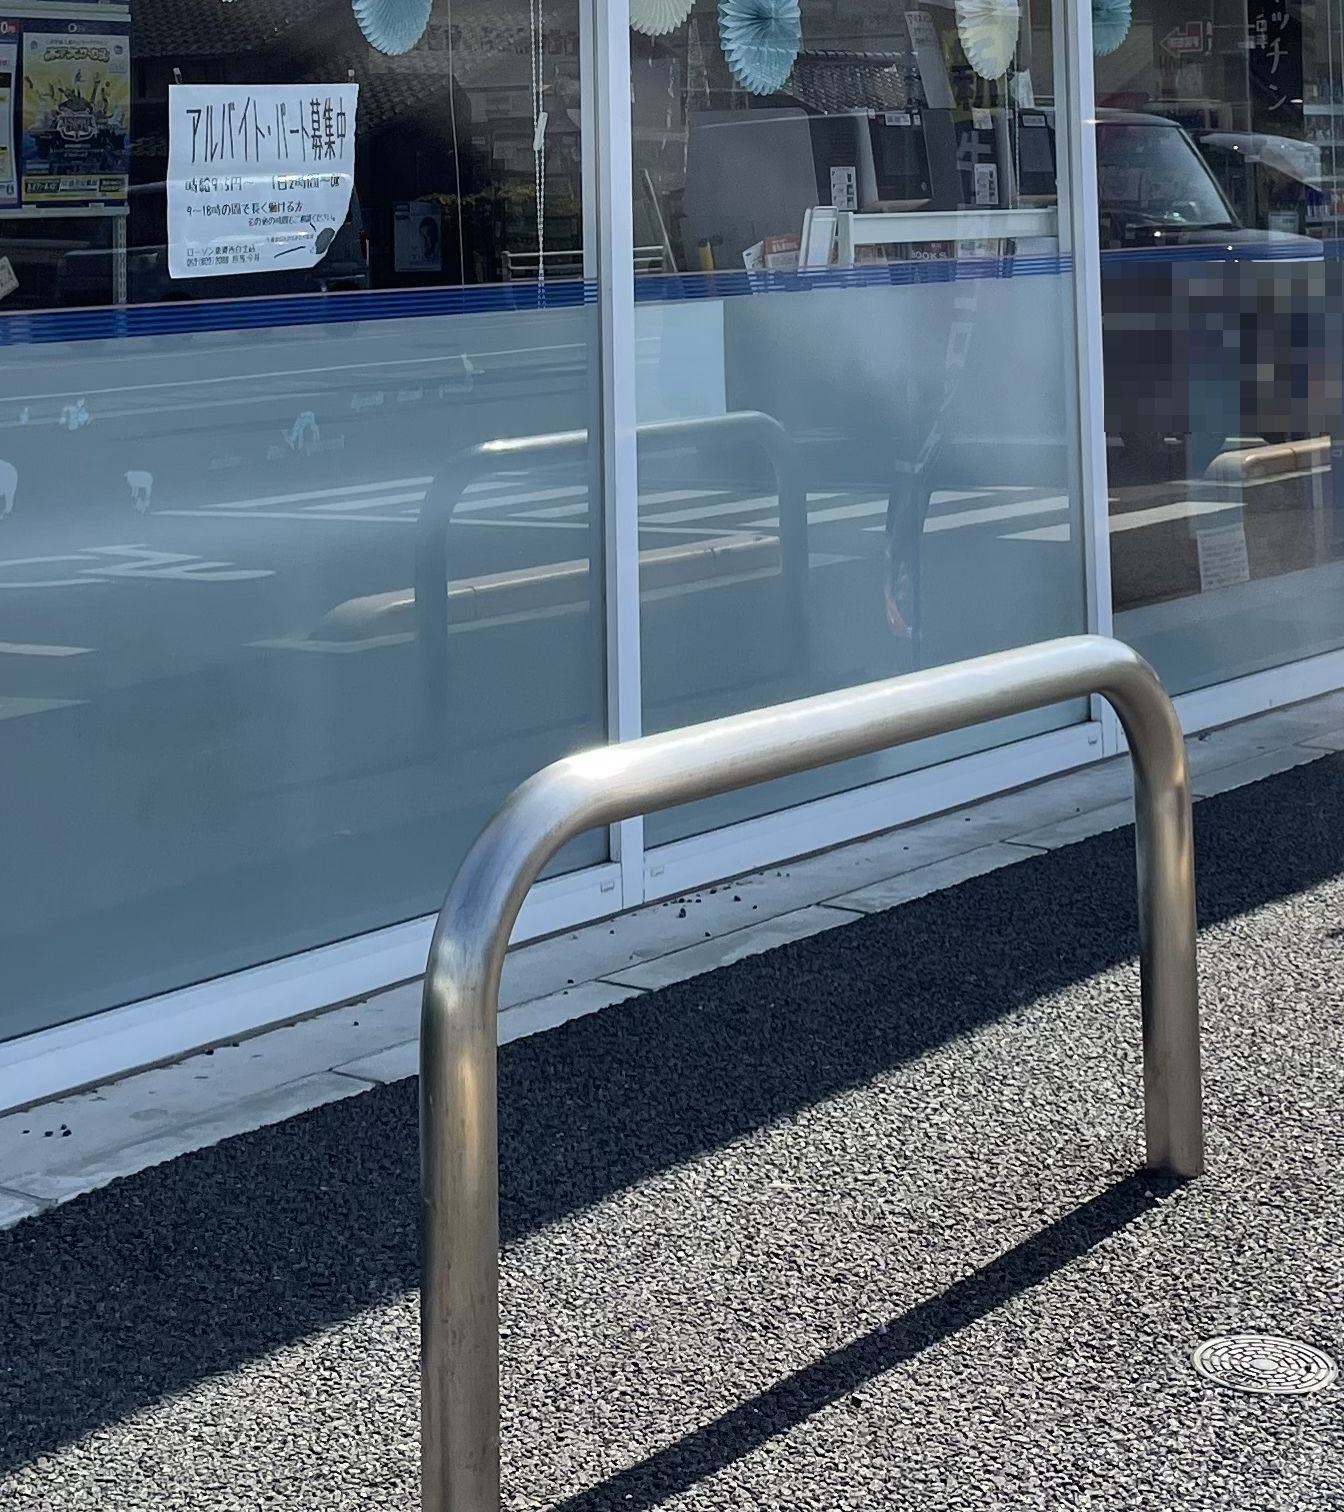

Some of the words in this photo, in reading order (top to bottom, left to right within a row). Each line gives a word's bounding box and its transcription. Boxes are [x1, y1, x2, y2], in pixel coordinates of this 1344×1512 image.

[186, 96, 347, 164] アルバイト・パート募集中
